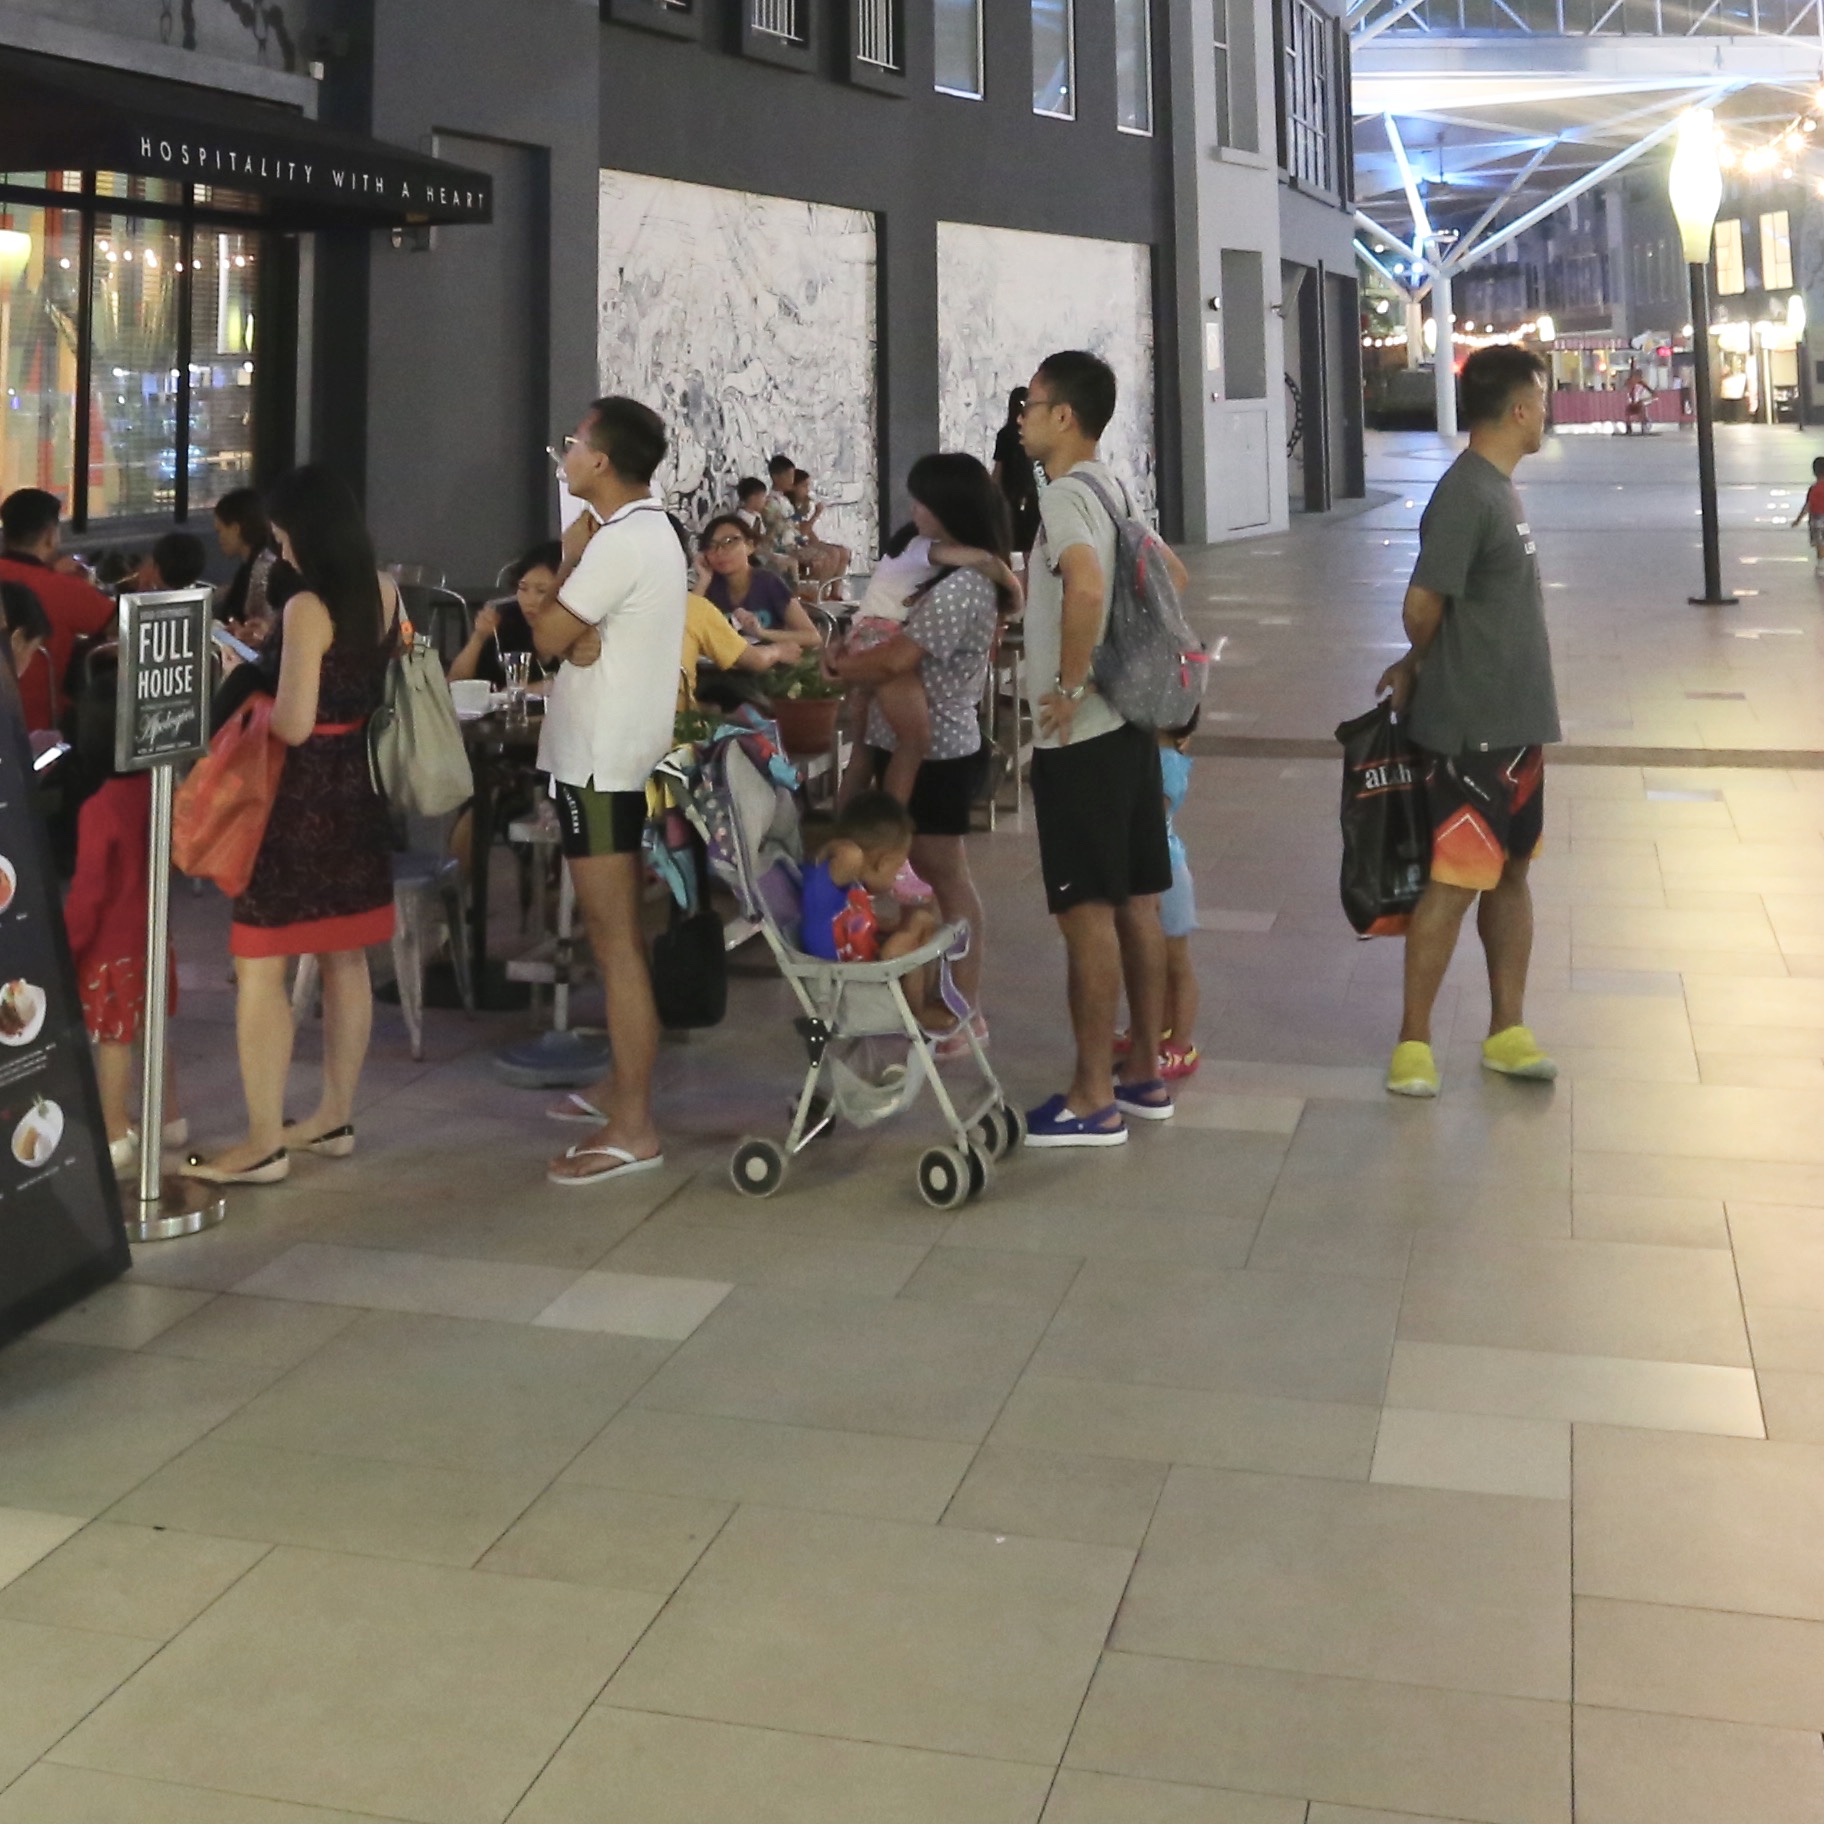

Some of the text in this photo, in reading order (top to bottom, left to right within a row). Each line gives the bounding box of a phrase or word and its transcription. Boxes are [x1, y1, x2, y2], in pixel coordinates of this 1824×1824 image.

[140, 136, 485, 210] HOSPITALITY WITH A HEART
[138, 618, 194, 665] FULL
[137, 665, 194, 699] HOUSE
